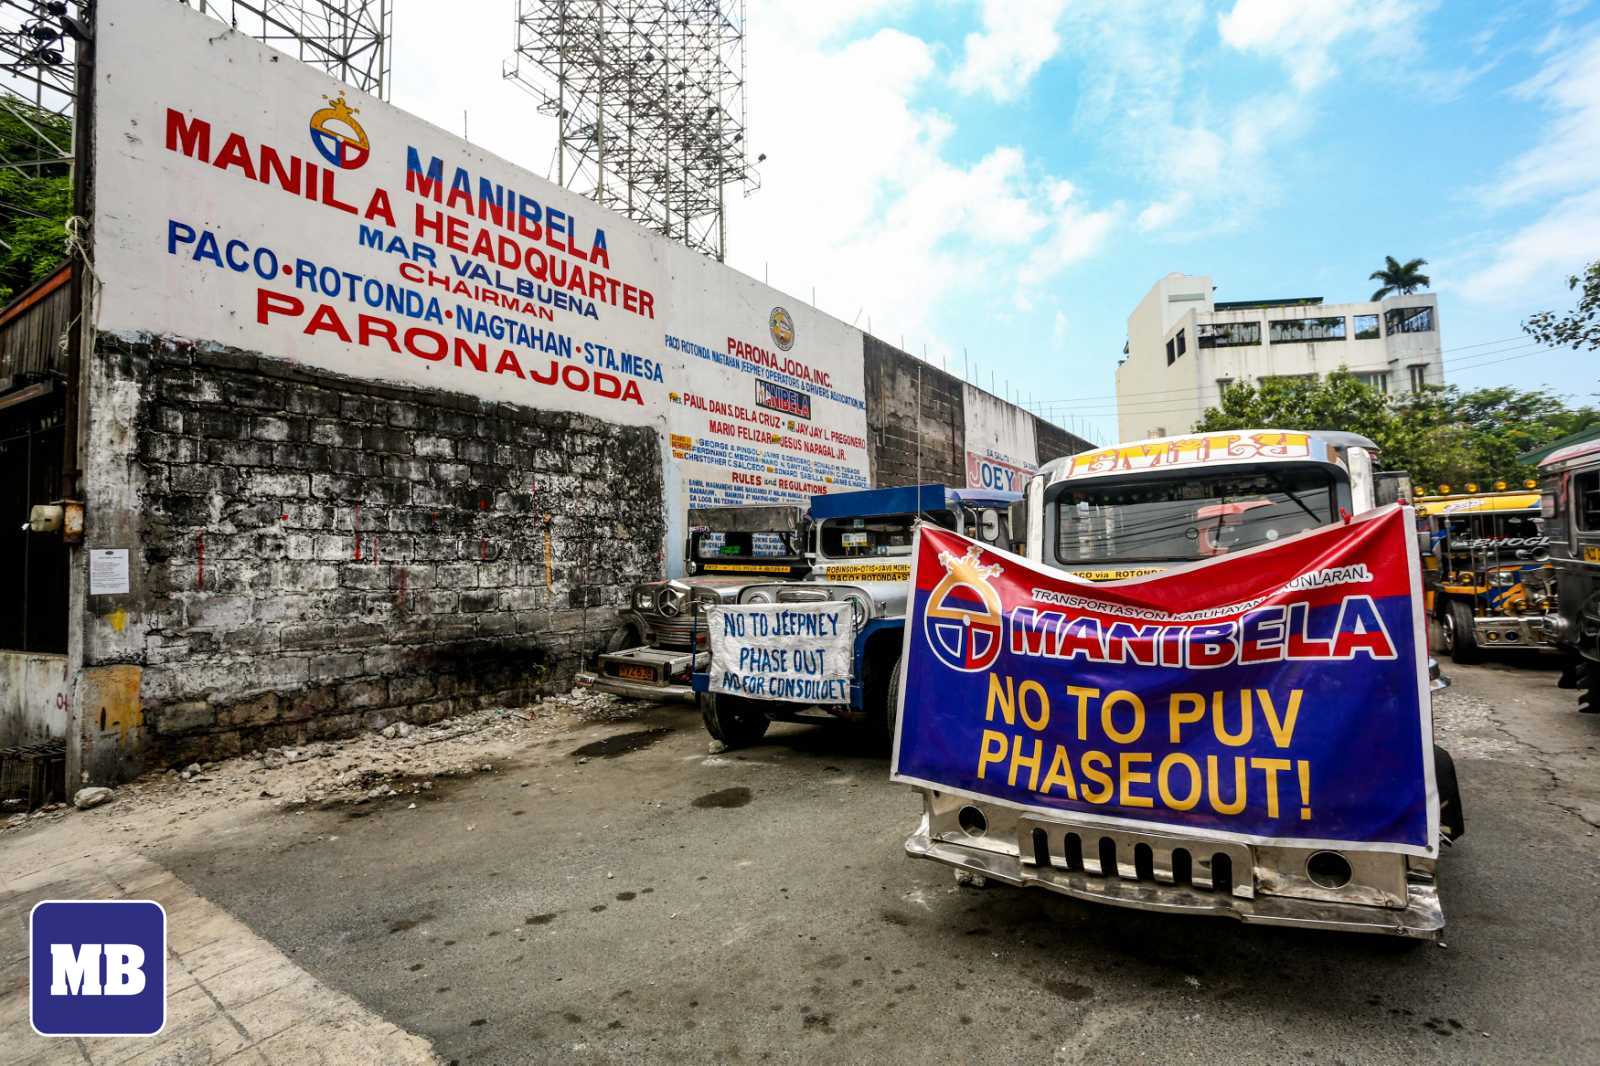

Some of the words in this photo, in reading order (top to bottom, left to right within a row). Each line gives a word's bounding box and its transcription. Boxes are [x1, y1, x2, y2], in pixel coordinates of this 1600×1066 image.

[166, 108, 396, 228] MANILA
[415, 203, 655, 319] HEADQUARTER
[406, 145, 609, 269] MANIBELA
[168, 219, 278, 280] PACO
[296, 258, 444, 325] ROTONDA
[456, 304, 571, 359] NAGTAHAN
[359, 224, 437, 268] MAR
[450, 254, 599, 320] VALBUENA
[400, 262, 553, 322] CHAIRMAN
[683, 392, 707, 411] PAUL
[709, 400, 727, 416] DAN
[758, 413, 781, 429] CRUZ
[709, 420, 736, 437] MARIO
[737, 426, 773, 445] FELIZAR
[780, 436, 802, 450] JESUS
[699, 438, 729, 451] GEORGE
[732, 471, 762, 486] RULES
[779, 479, 828, 495] REGULATIONS
[723, 612, 745, 637] NO
[749, 612, 768, 637] TO
[772, 609, 839, 637] JEEPNEY
[1010, 595, 1398, 669] MANIBELA
[740, 647, 788, 673] PHASE
[793, 649, 826, 676] OUT
[742, 675, 765, 695] FOR
[985, 672, 1050, 731] NO
[1067, 686, 1145, 744] TO
[1169, 689, 1303, 749] PUV
[977, 730, 1311, 820] PHASEOUT!
